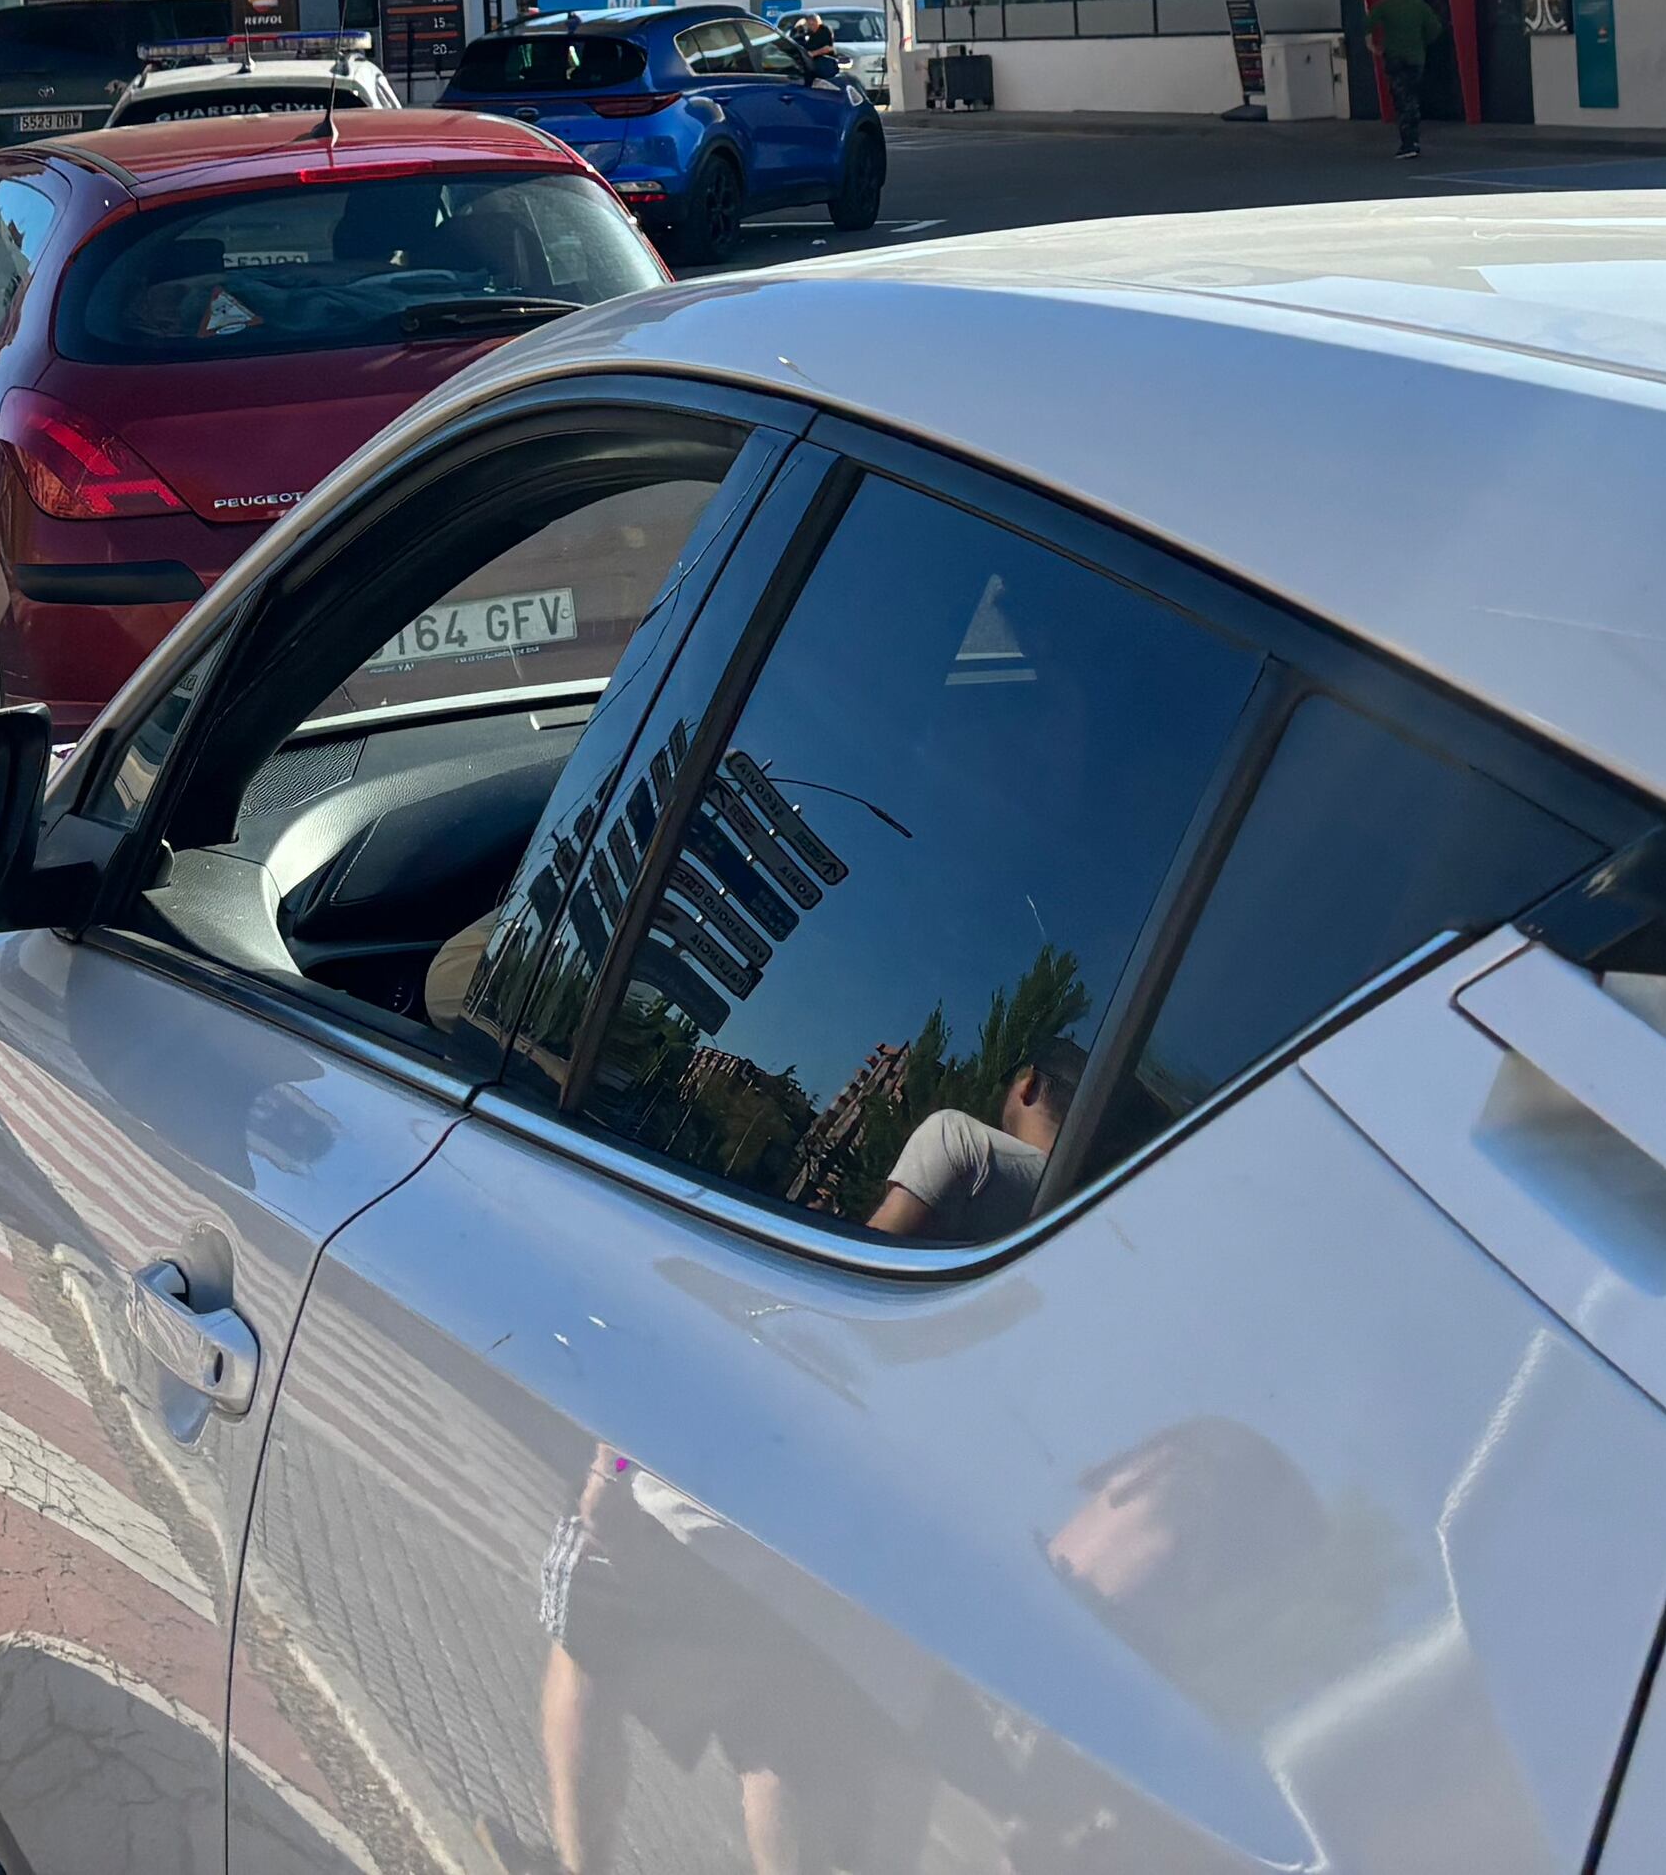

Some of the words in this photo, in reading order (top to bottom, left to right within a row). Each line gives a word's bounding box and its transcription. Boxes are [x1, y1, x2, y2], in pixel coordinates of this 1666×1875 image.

[433, 17, 445, 29] 15
[433, 43, 448, 55] 20
[156, 101, 265, 123] GUARDIA
[213, 491, 305, 509] PEUGEOT
[370, 609, 468, 660] 164
[486, 595, 562, 642] GFV
